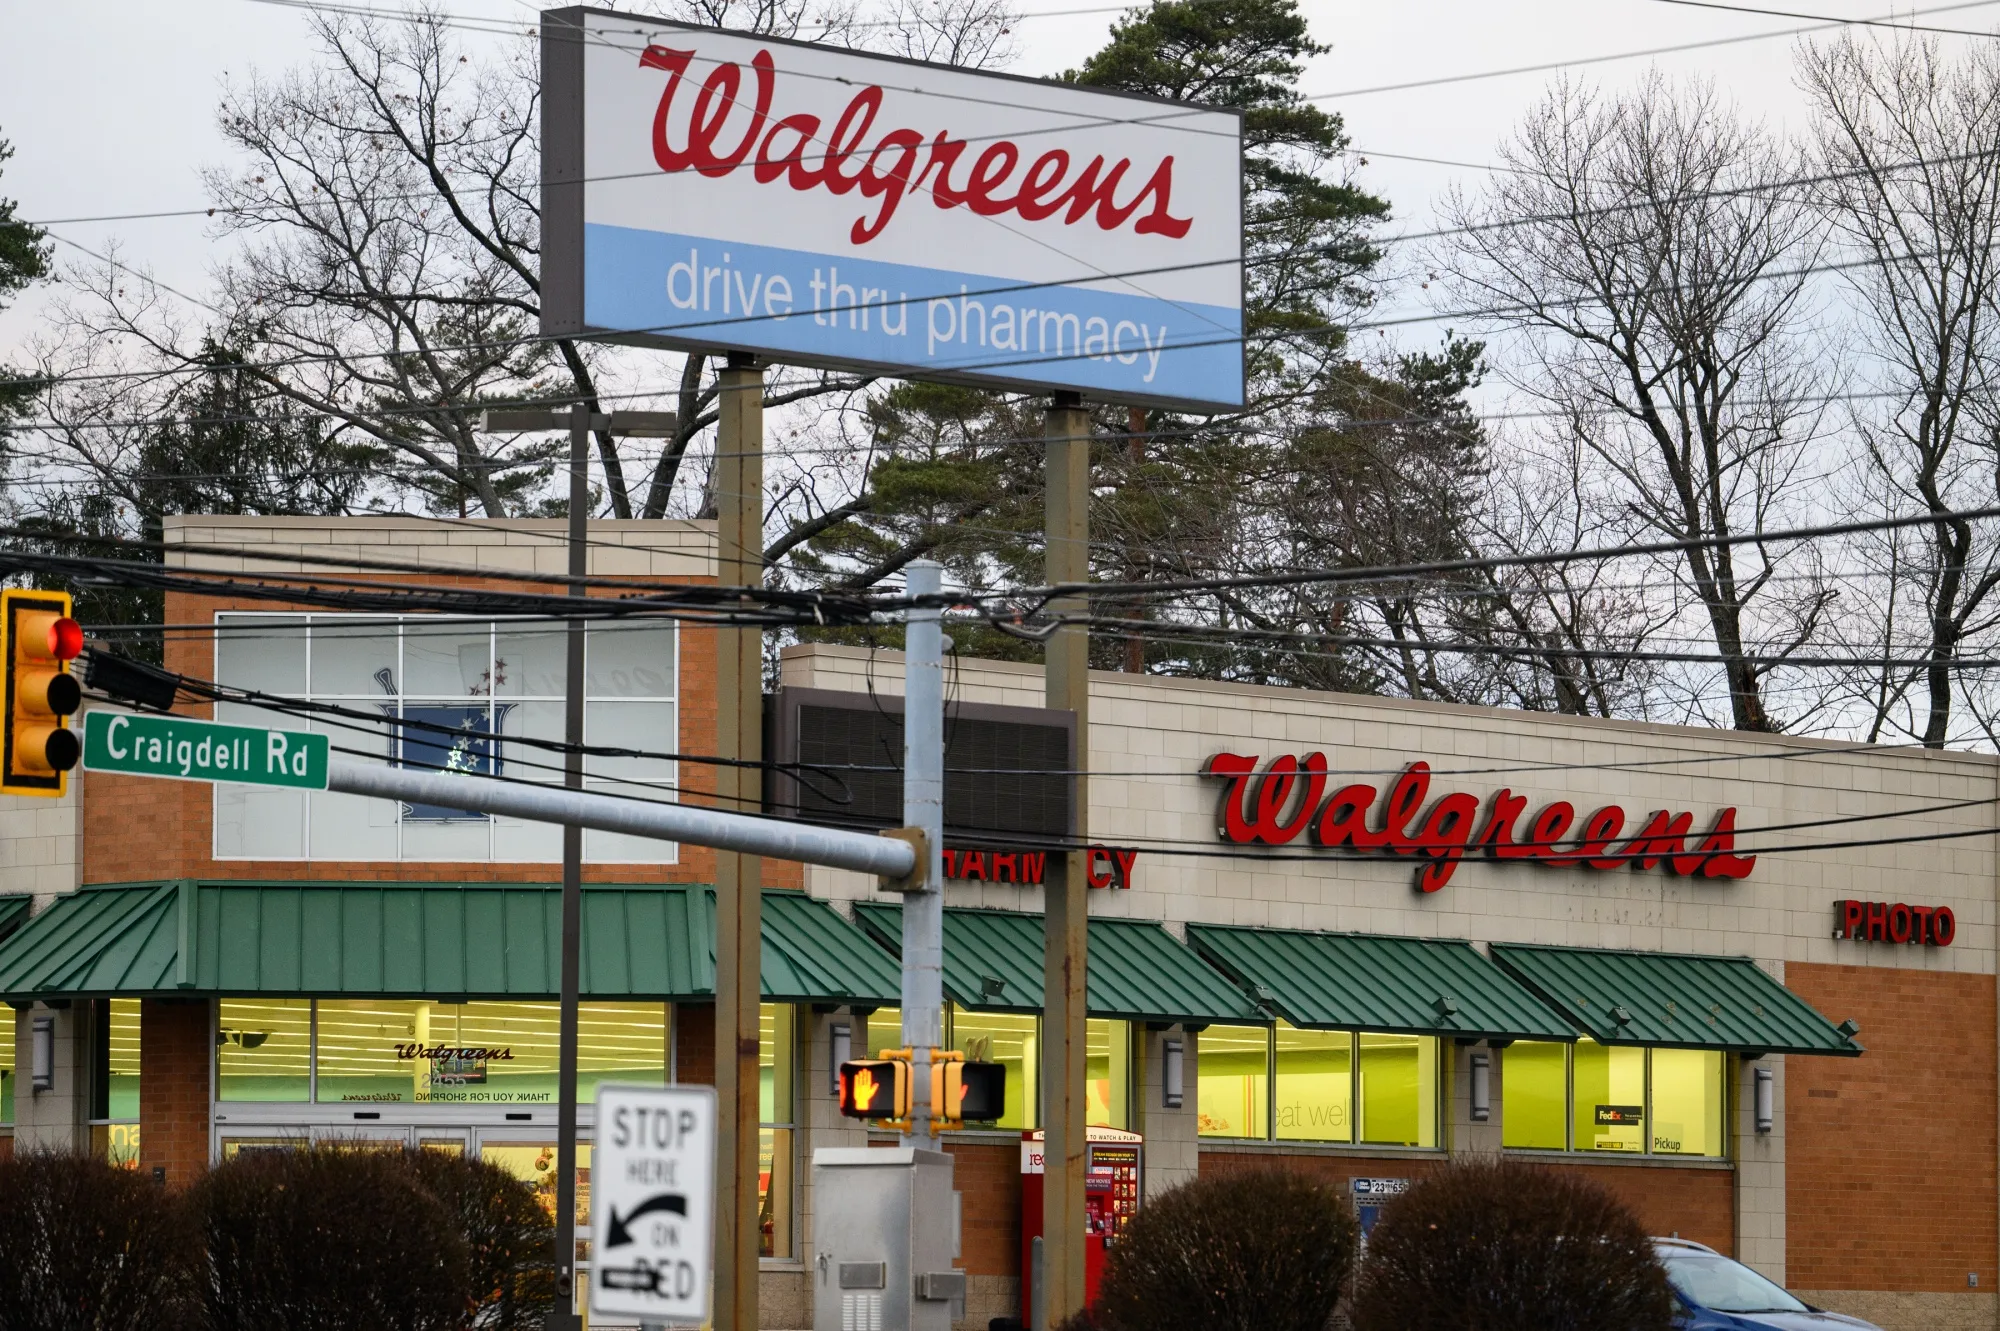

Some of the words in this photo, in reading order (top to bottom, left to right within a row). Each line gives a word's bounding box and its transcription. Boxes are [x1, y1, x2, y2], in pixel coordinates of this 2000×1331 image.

[639, 44, 1194, 245] Walgreens
[667, 248, 793, 322] drive
[810, 266, 907, 337] thru
[927, 284, 1167, 384] pharmacy
[107, 715, 249, 776] Craigdell
[267, 731, 308, 777] Rd
[1202, 751, 1757, 894] Walgreens
[942, 844, 1140, 889] ARMCY
[1844, 900, 1955, 947] PHOTO
[394, 1044, 515, 1065] Walgreens
[421, 1073, 466, 1089] 2455
[612, 1106, 697, 1150] STOP
[1599, 1110, 1621, 1120] FedEx
[1654, 1137, 1681, 1152] Pickup
[626, 1158, 677, 1186] HERE
[652, 1221, 681, 1248] ON
